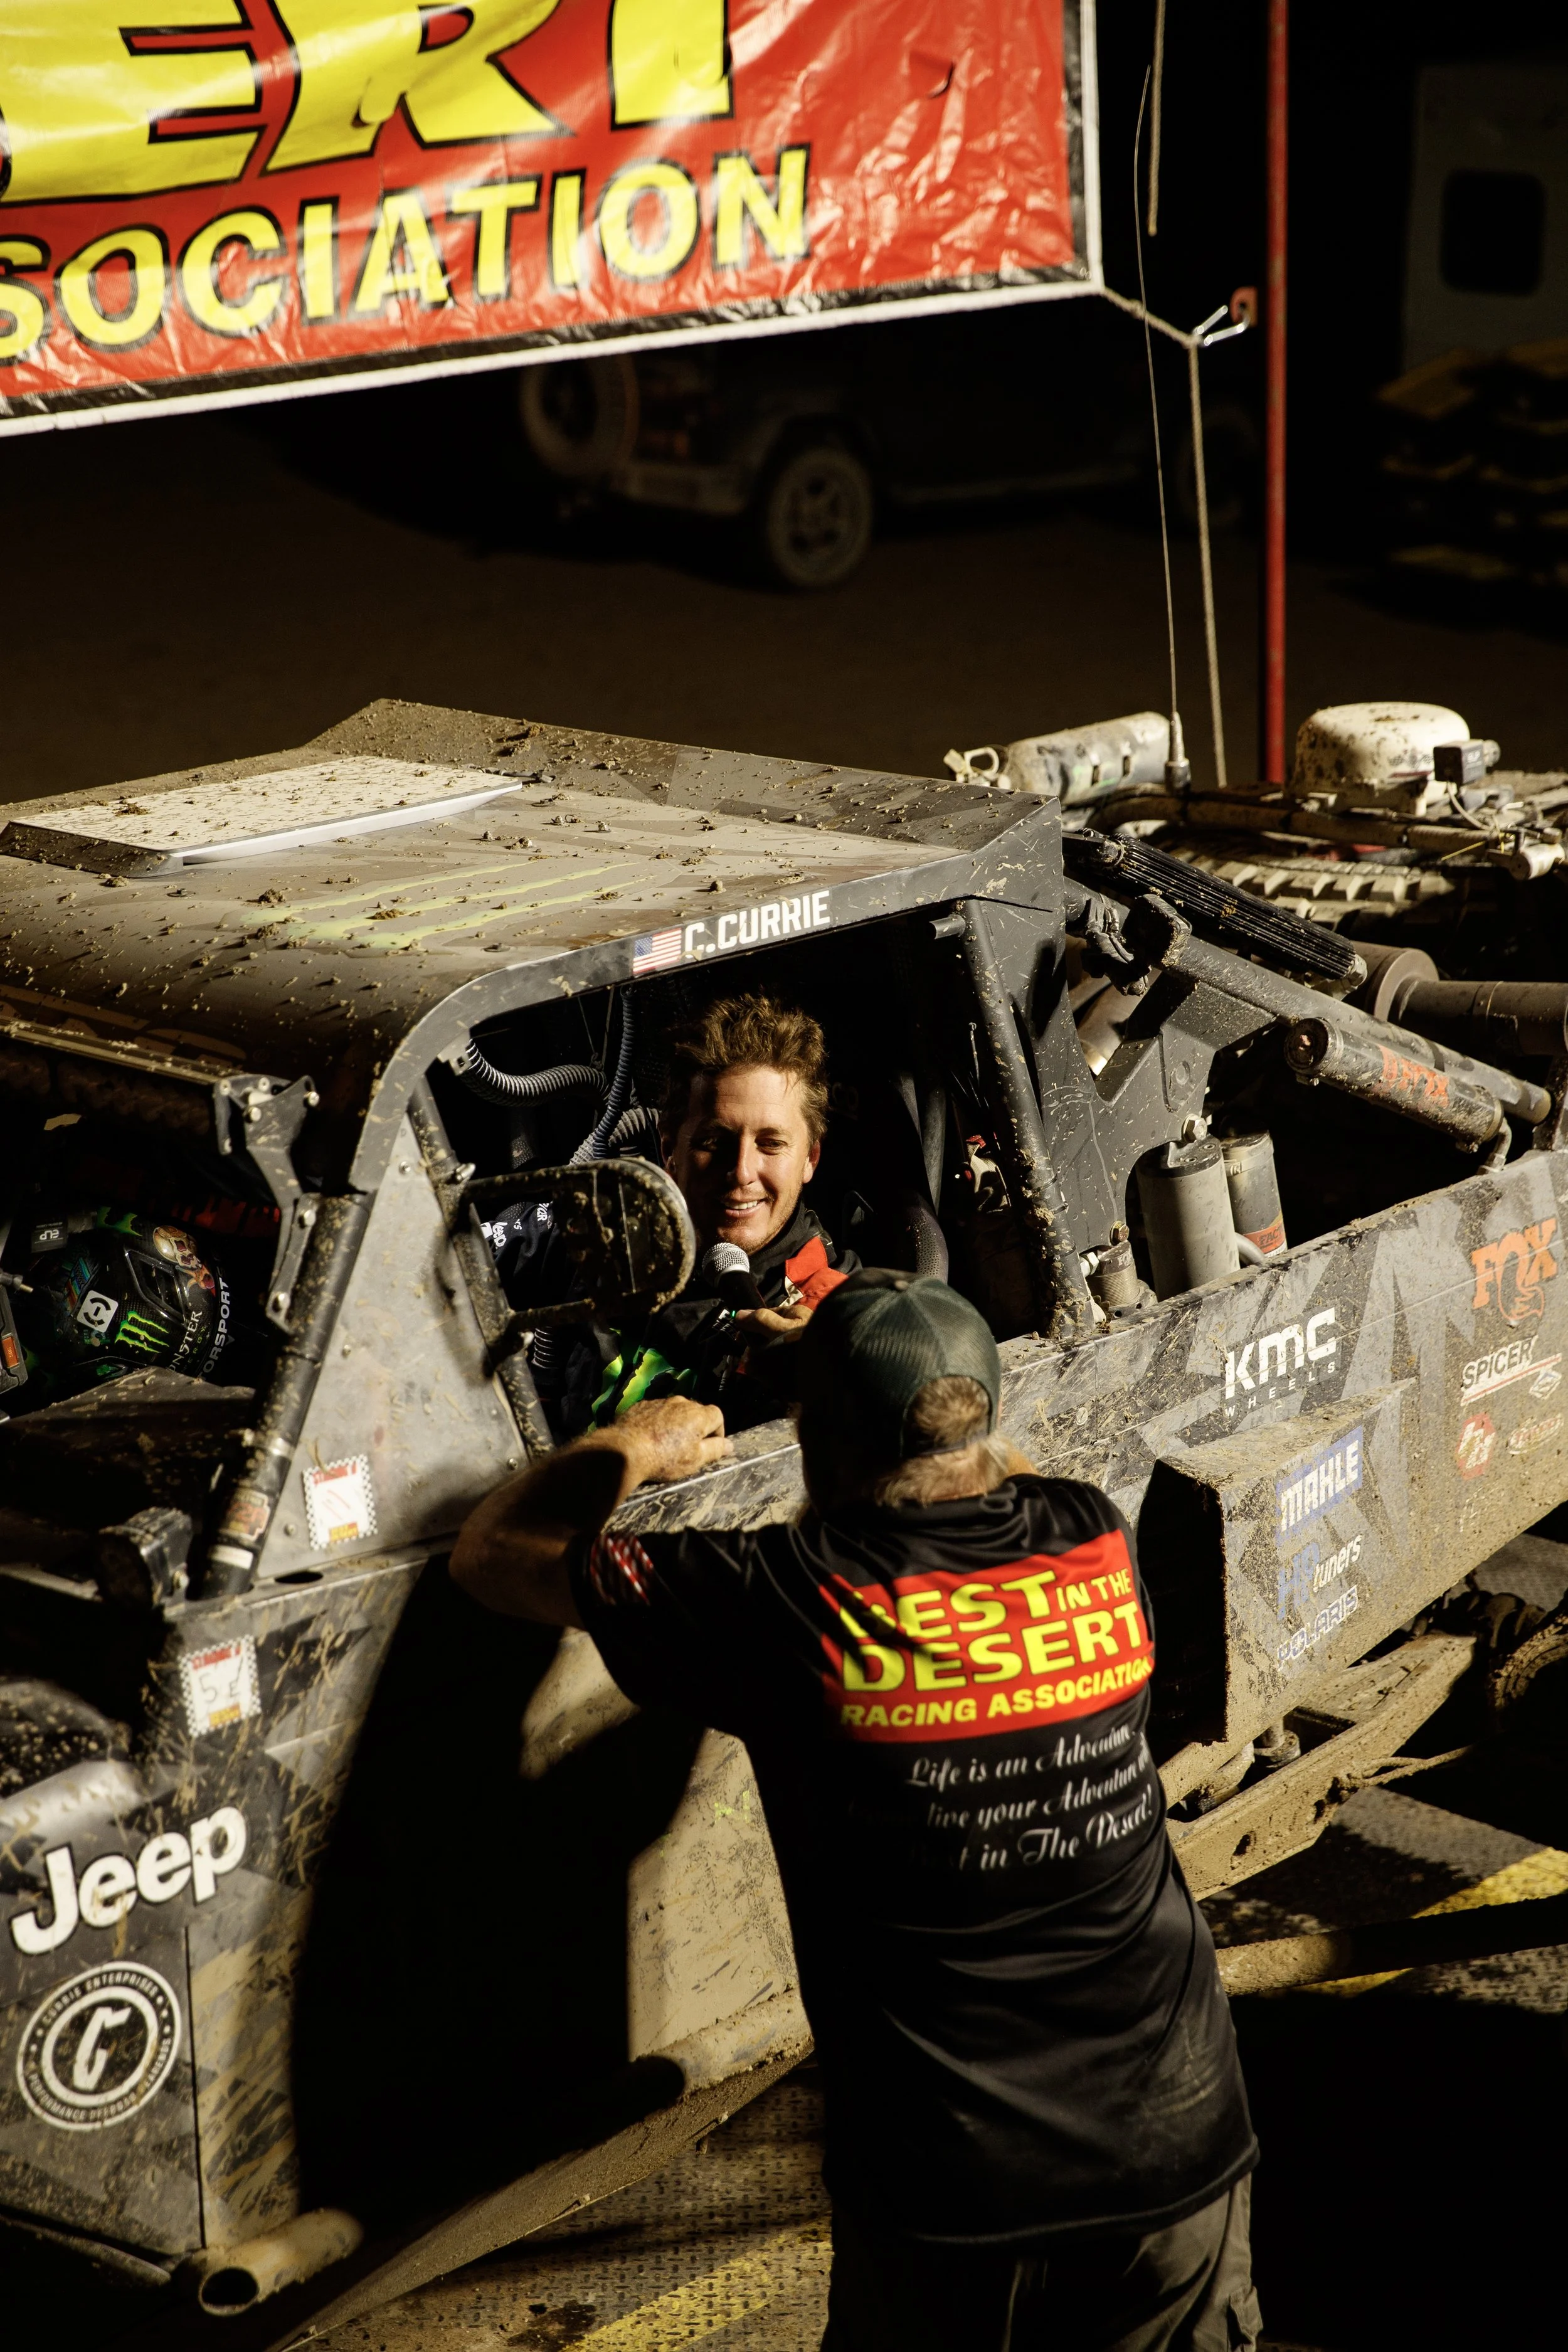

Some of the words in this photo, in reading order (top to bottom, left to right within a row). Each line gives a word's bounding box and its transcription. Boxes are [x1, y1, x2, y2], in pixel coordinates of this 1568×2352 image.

[1471, 1218, 1559, 1321] FOX
[1224, 1361, 1337, 1417] WHEELS
[1462, 1338, 1534, 1390] SPICER
[1280, 1440, 1360, 1532] MAHLE
[1056, 1581, 1092, 1613] IN
[1091, 1567, 1132, 1602] THE
[1313, 1534, 1362, 1594] tuners
[842, 1601, 1143, 1693] DESERT
[1276, 1584, 1359, 1673] POLARIS
[840, 1697, 977, 1728] RACING
[904, 1757, 961, 1793] Life
[968, 1758, 987, 1783] is
[995, 1757, 1028, 1779] an
[978, 1798, 1038, 1831] your
[1017, 1826, 1081, 1866] The
[11, 1806, 247, 1955] Jeep
[85, 1971, 159, 1997] ENTERPRISES
[28, 2072, 85, 2120] PERFORMANCE
